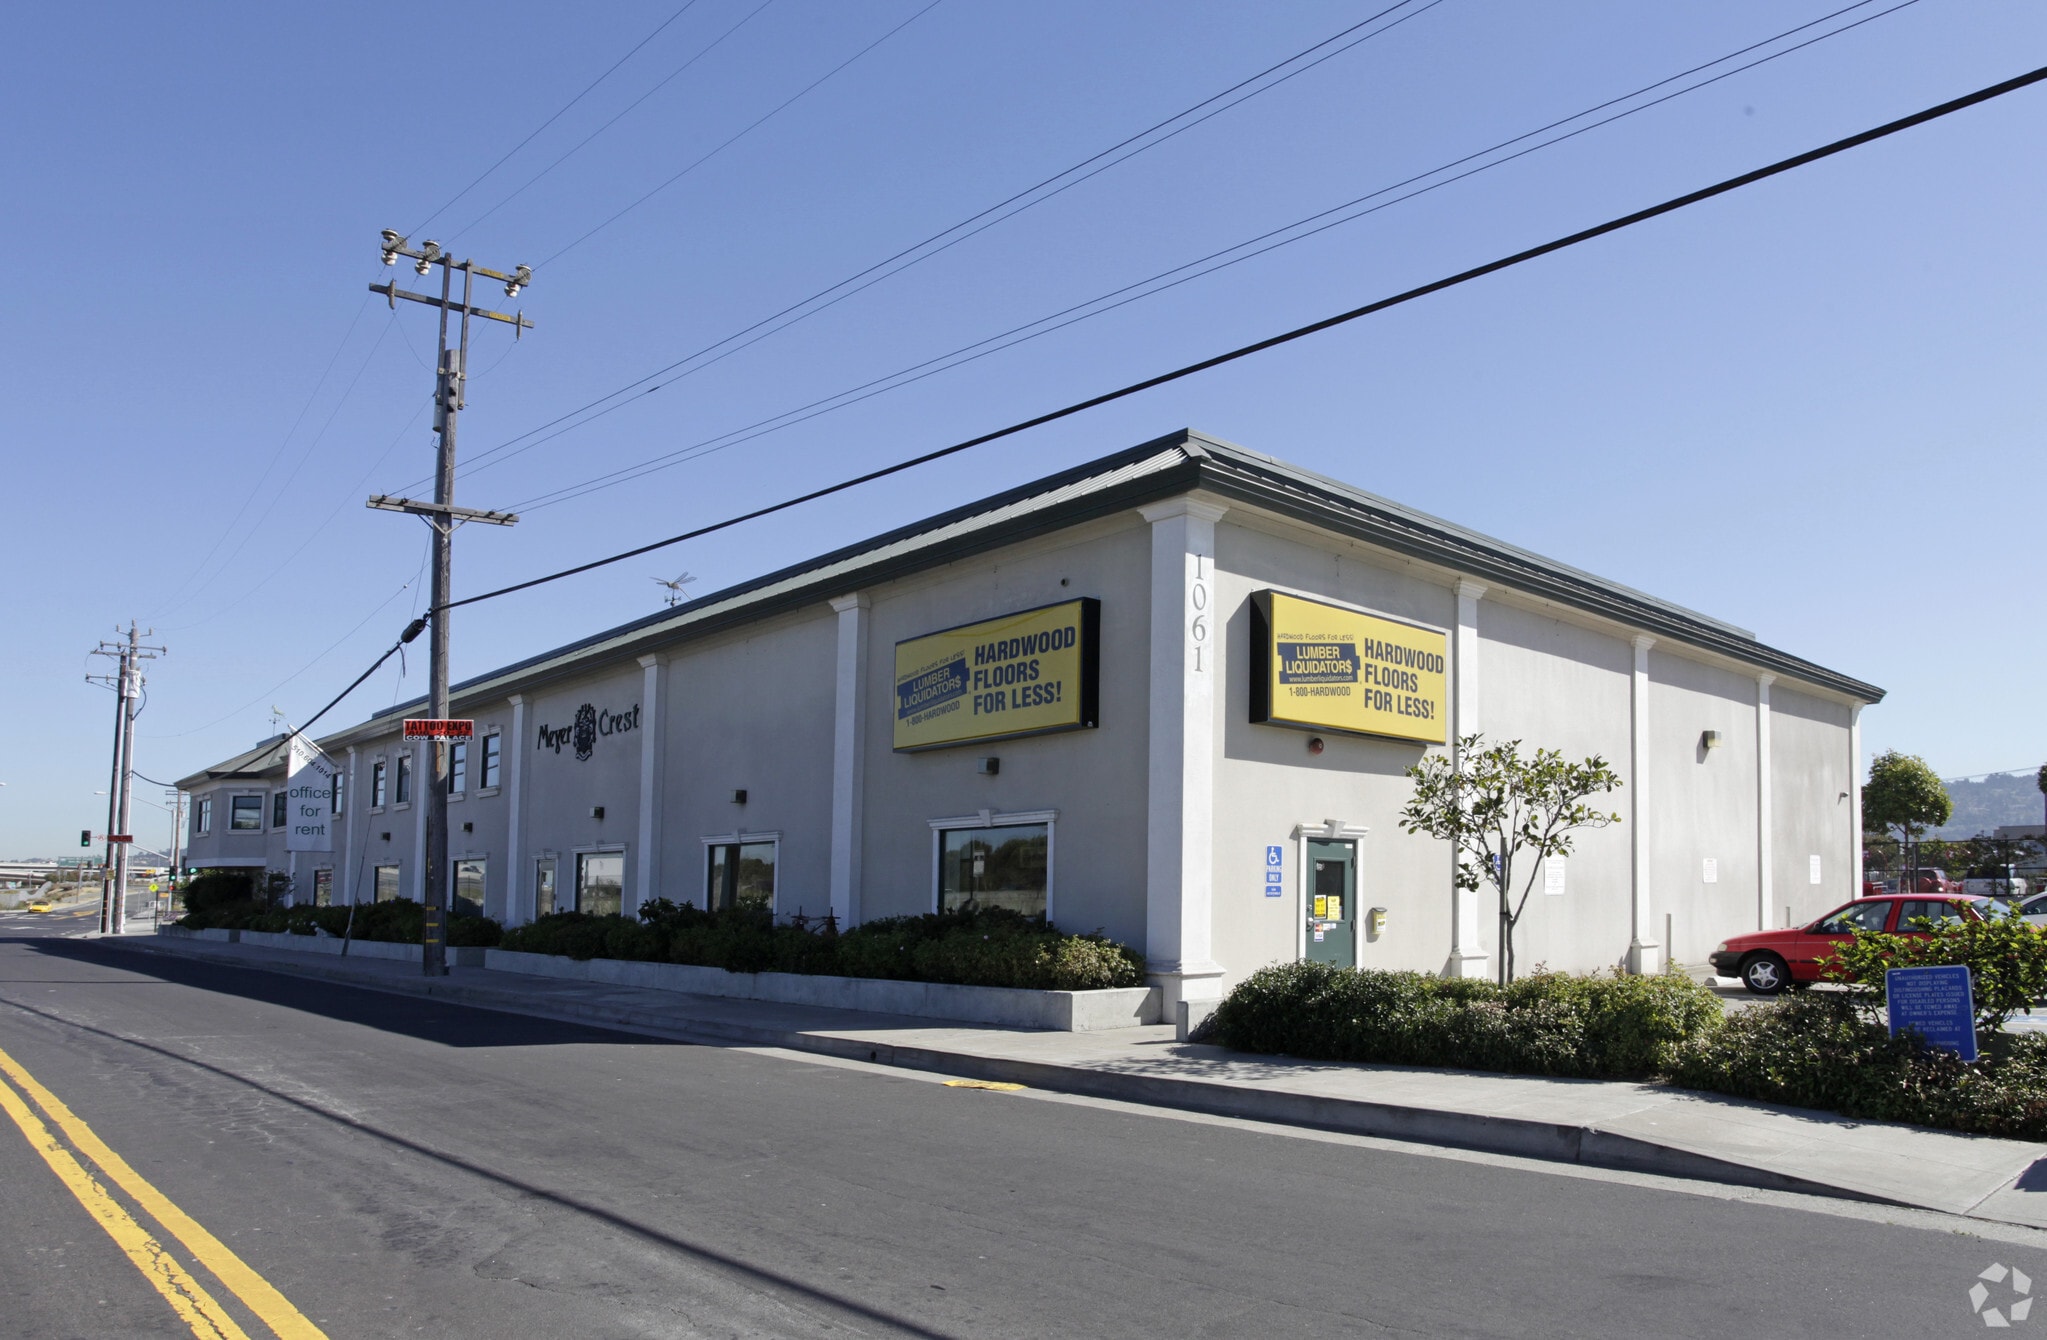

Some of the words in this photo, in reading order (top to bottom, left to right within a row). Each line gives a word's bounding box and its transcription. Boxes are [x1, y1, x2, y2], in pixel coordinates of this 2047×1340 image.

[1192, 554, 1206, 672] 1061
[974, 626, 1076, 666] HARDWOOD
[1296, 646, 1340, 659] LUMBER
[1364, 637, 1444, 675] HARDWOOD
[913, 668, 950, 692] LUMBER
[974, 659, 1039, 691] FLOORS
[1289, 674, 1353, 683] www.lumberliquidators.com
[1364, 662, 1418, 693] FLOORS
[973, 690, 1006, 715] FOR
[1012, 681, 1062, 709] LESS!
[1289, 686, 1351, 696] 1-800-HARDWOOD
[1364, 688, 1393, 713] FOR
[1397, 694, 1435, 720] LESS!
[405, 721, 443, 730] TATTOO
[447, 721, 472, 730] EXPO
[906, 700, 960, 727] 1-800-HARDWOOD
[537, 724, 573, 754] Meyer
[599, 703, 640, 736] Crest
[289, 786, 331, 799] office
[300, 804, 321, 817] for
[295, 824, 325, 836] rent
